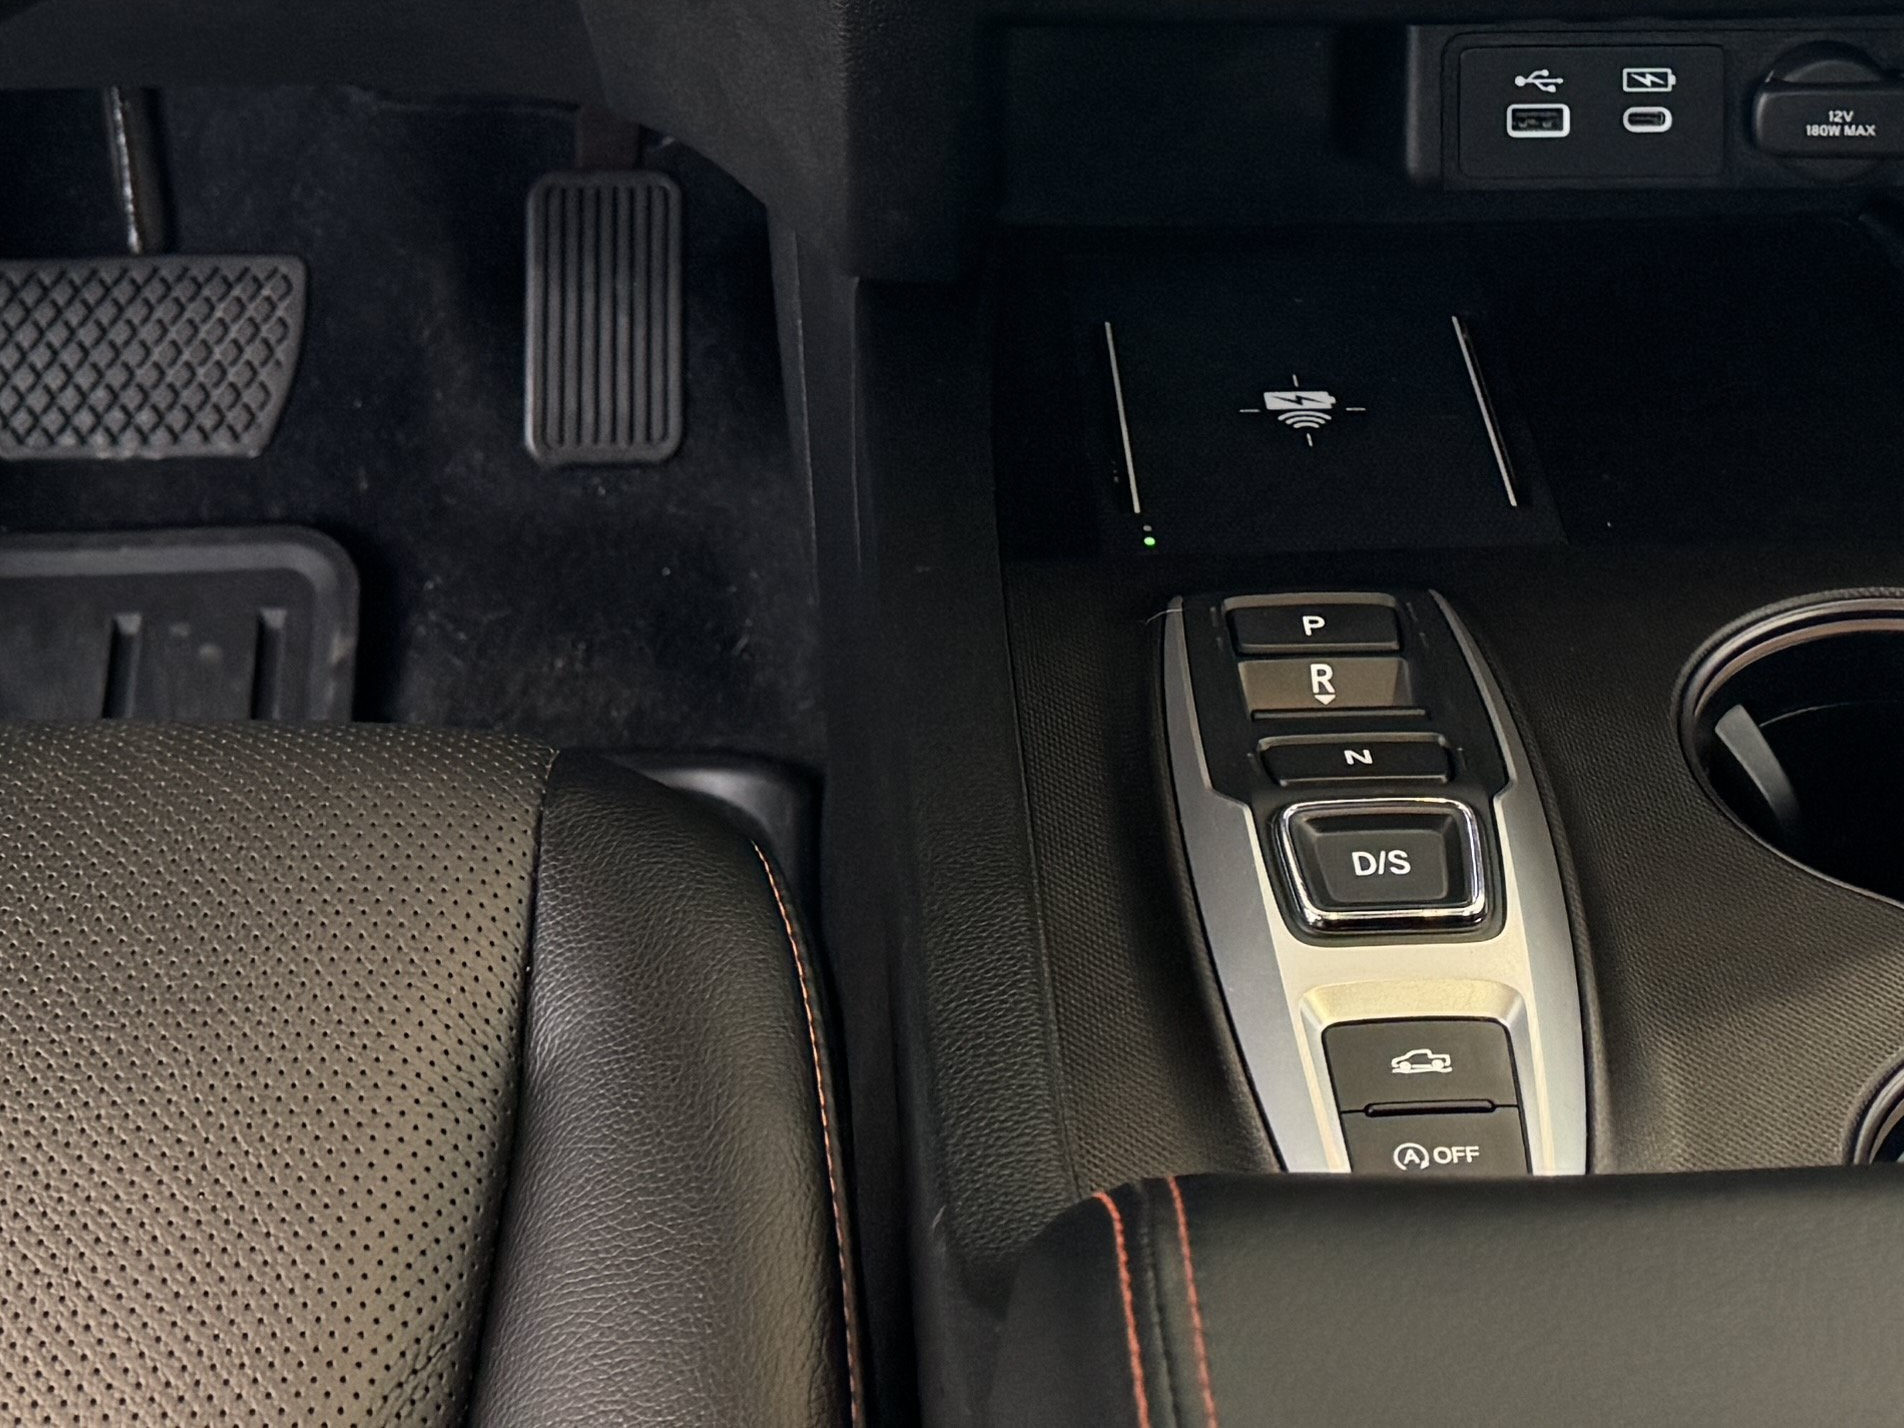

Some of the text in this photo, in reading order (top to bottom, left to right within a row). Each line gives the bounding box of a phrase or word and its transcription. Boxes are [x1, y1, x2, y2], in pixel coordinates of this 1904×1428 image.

[1827, 109, 1854, 124] 12V
[1805, 123, 1877, 138] 180W MAX
[1302, 615, 1326, 637] P
[1310, 663, 1336, 694] R
[1343, 748, 1374, 766] N
[1352, 849, 1412, 877] D/S
[1432, 1145, 1481, 1165] OFF
